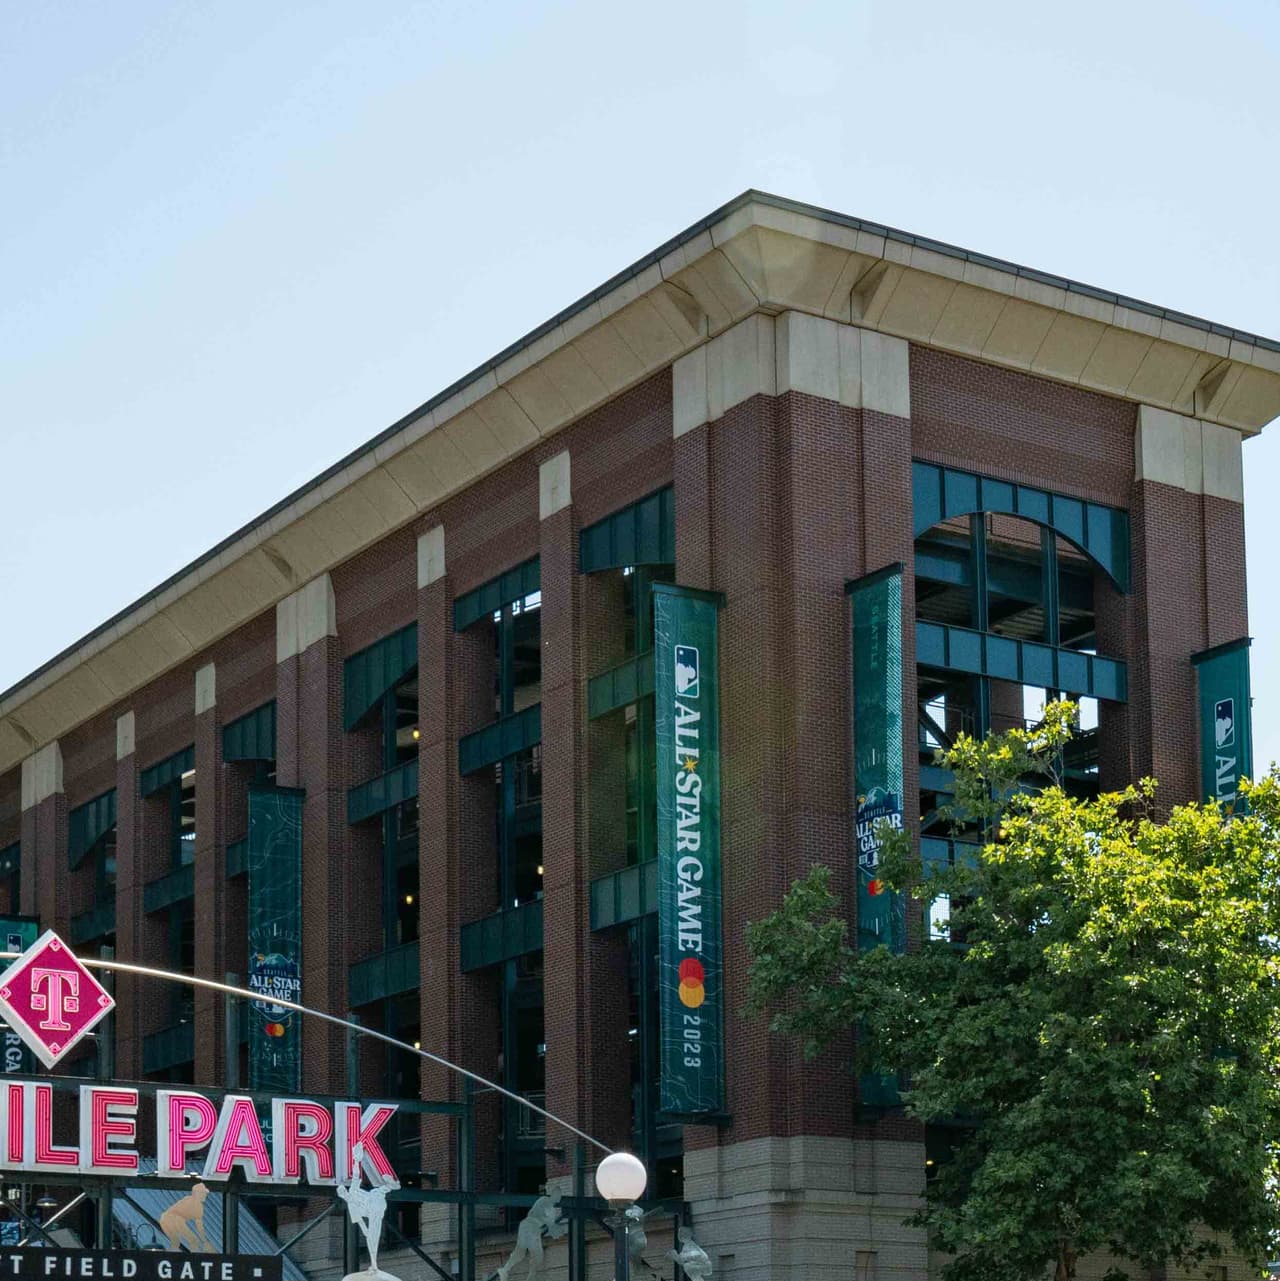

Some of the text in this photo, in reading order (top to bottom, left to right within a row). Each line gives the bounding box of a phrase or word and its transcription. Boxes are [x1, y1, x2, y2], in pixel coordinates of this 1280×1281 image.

[675, 700, 704, 952] ALL STAR GAME
[31, 967, 80, 1031] T
[684, 1015, 701, 1068] 2023
[157, 1089, 401, 1190] PARK
[44, 1255, 138, 1279] FIELD
[157, 1260, 235, 1281] GATE
